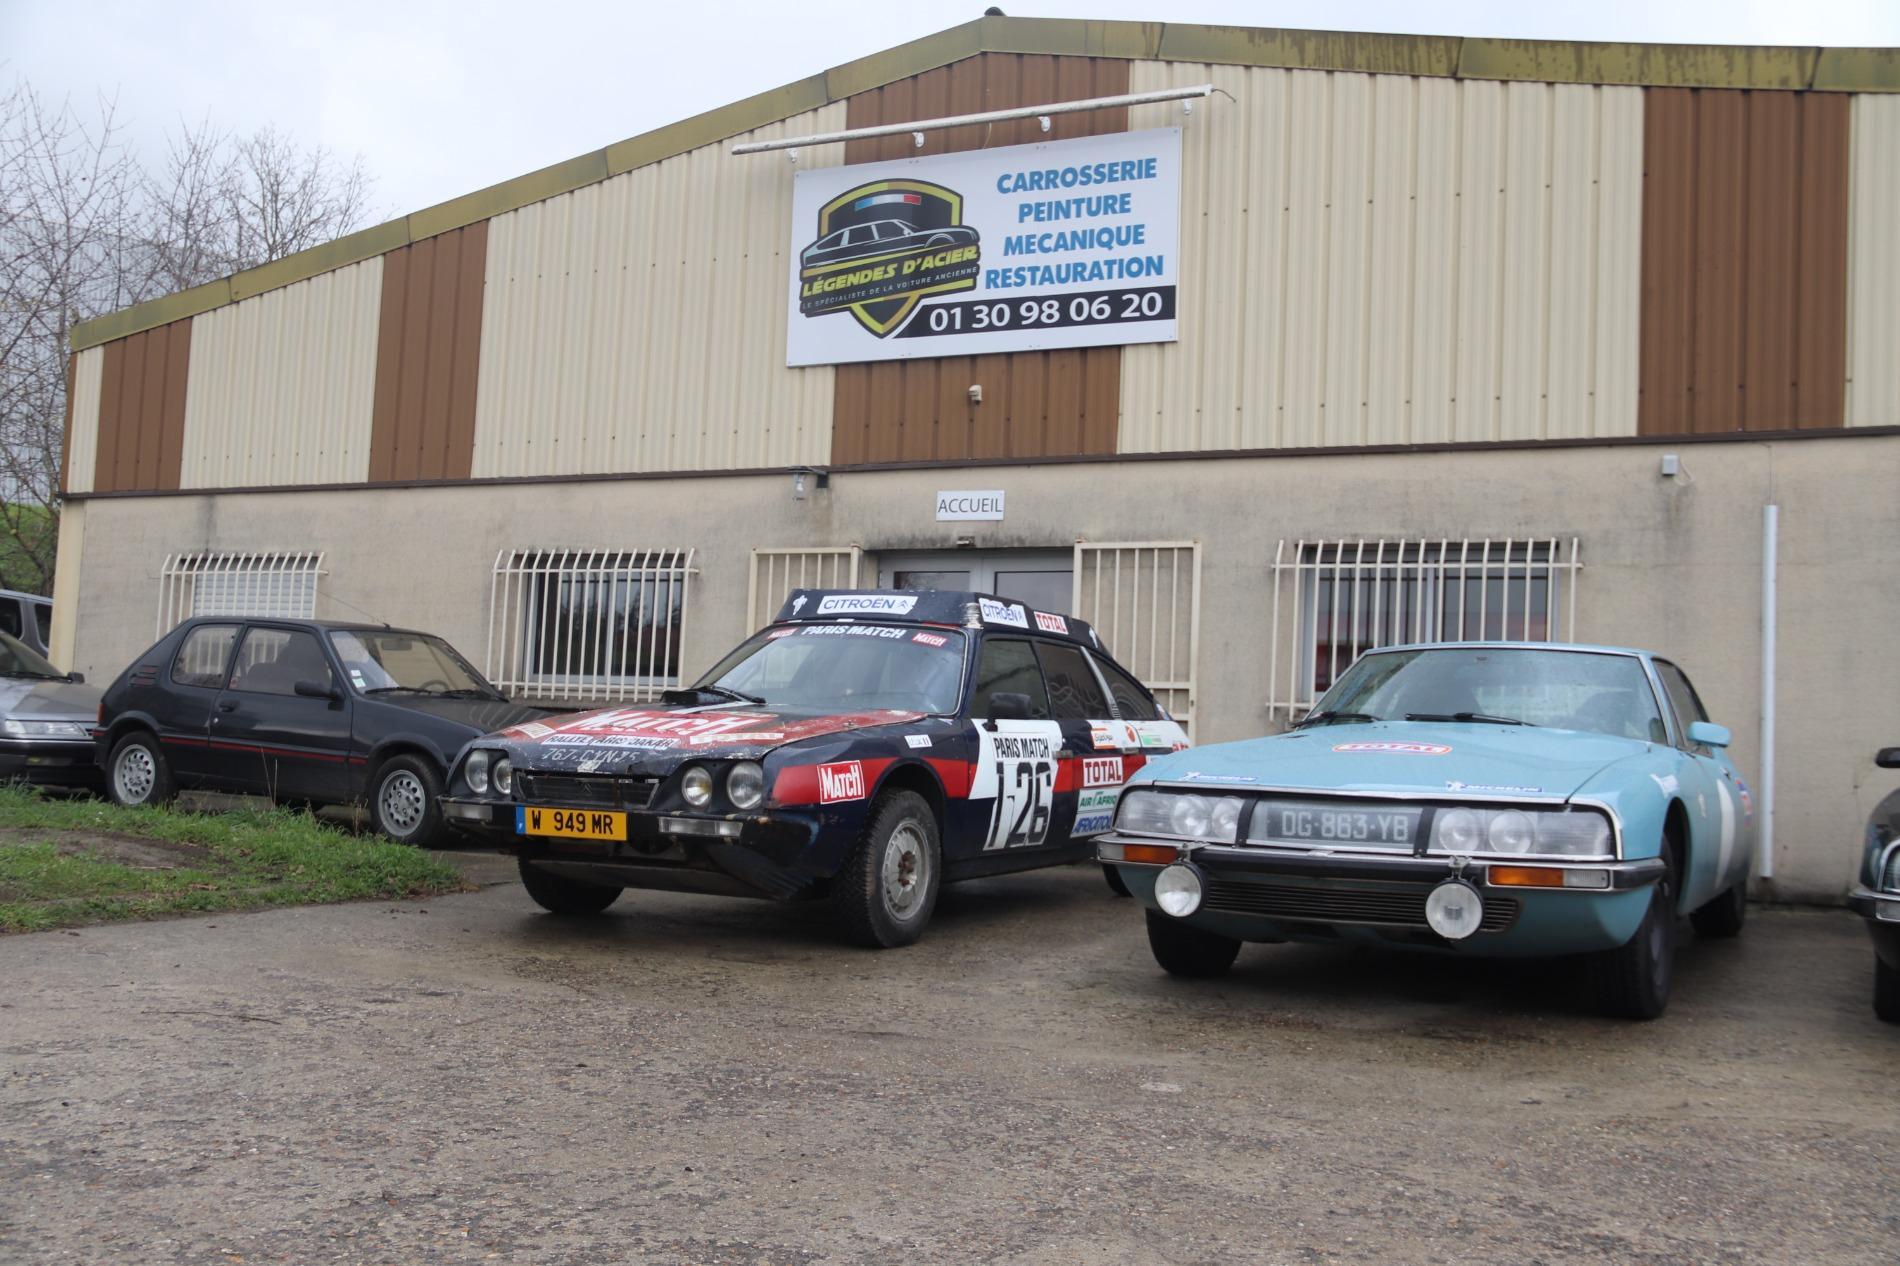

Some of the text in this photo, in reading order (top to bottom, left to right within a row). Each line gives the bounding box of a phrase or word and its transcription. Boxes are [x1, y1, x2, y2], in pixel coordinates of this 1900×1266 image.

[997, 157, 1157, 194] CARROSSERIE
[1018, 193, 1132, 224] PEINTURE
[1003, 224, 1145, 257] MECANIQUE
[802, 245, 978, 297] LÉGENDES D'ACIER
[869, 287, 881, 295] DE
[896, 276, 931, 289] VOITURE
[935, 266, 978, 281] ANCIENNE
[985, 255, 1164, 290] RESTAURATION
[929, 291, 1163, 331] 01 30 98 06 20
[937, 497, 1003, 513] ACCUEIL
[823, 596, 896, 610] CITROËN
[801, 625, 907, 639] PARIS MATCH
[1035, 613, 1067, 633] TOTAL
[912, 632, 948, 647] MATCH
[993, 737, 1050, 759] PARIS MATCH
[820, 764, 862, 800] MATCH
[1085, 760, 1123, 784] TOTAL
[987, 762, 1052, 848] 126
[1080, 797, 1092, 807] AIR
[531, 810, 613, 835] W 949 MR
